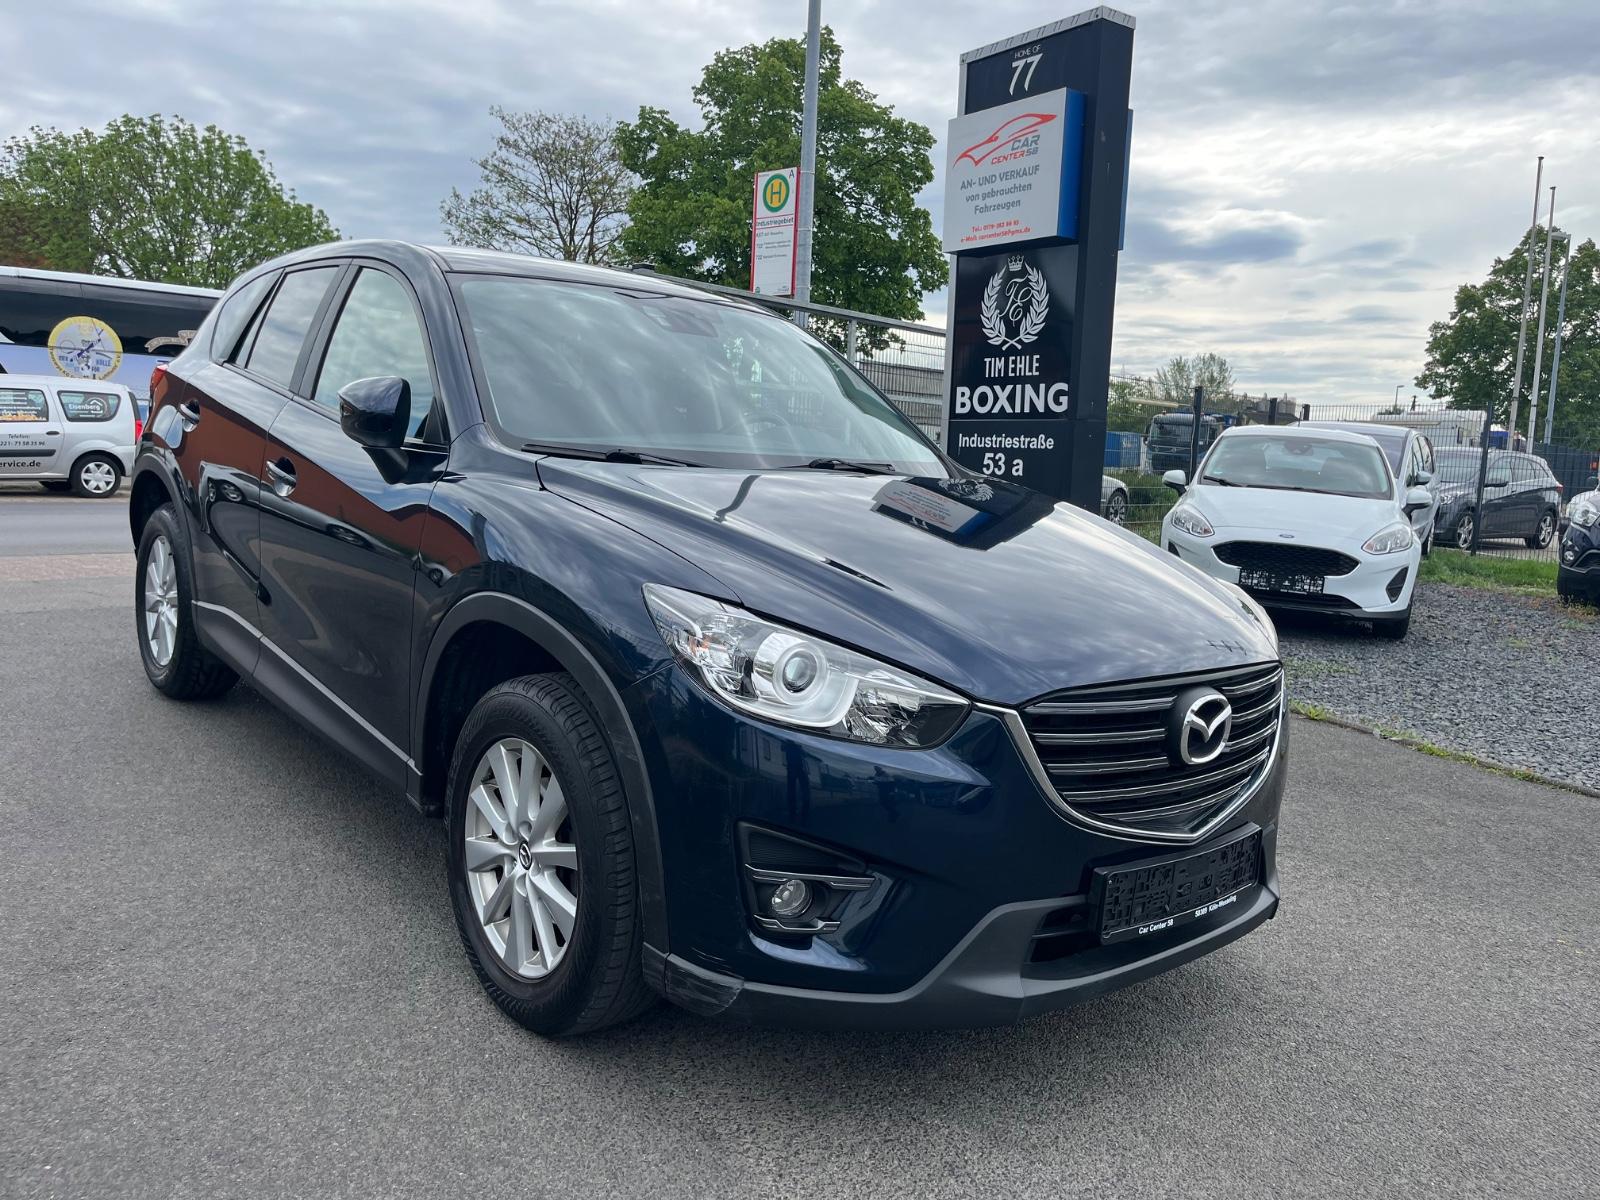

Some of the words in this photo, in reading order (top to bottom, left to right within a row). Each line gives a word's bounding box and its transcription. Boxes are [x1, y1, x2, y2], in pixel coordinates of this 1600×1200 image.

[1014, 48, 1032, 59] HOME
[1033, 44, 1042, 53] OF
[1008, 53, 1044, 96] 77
[1010, 134, 1041, 151] CAR
[788, 169, 795, 179] A
[960, 179, 977, 191] AN-
[978, 174, 997, 187] UND
[999, 164, 1040, 182] VERKAUF
[965, 192, 980, 203] von
[981, 183, 1032, 201] gebrauchten
[974, 199, 1021, 215] Fahrzeugen
[984, 357, 1005, 378] TIM
[1008, 354, 1040, 377] EHLE
[955, 382, 1069, 414] BOXING
[958, 433, 1055, 450] Industriestraße
[982, 452, 1006, 476] 53
[1011, 459, 1024, 477] a
[1138, 927, 1149, 935] Car
[1149, 920, 1168, 932] Center
[1167, 918, 1174, 927] 58
